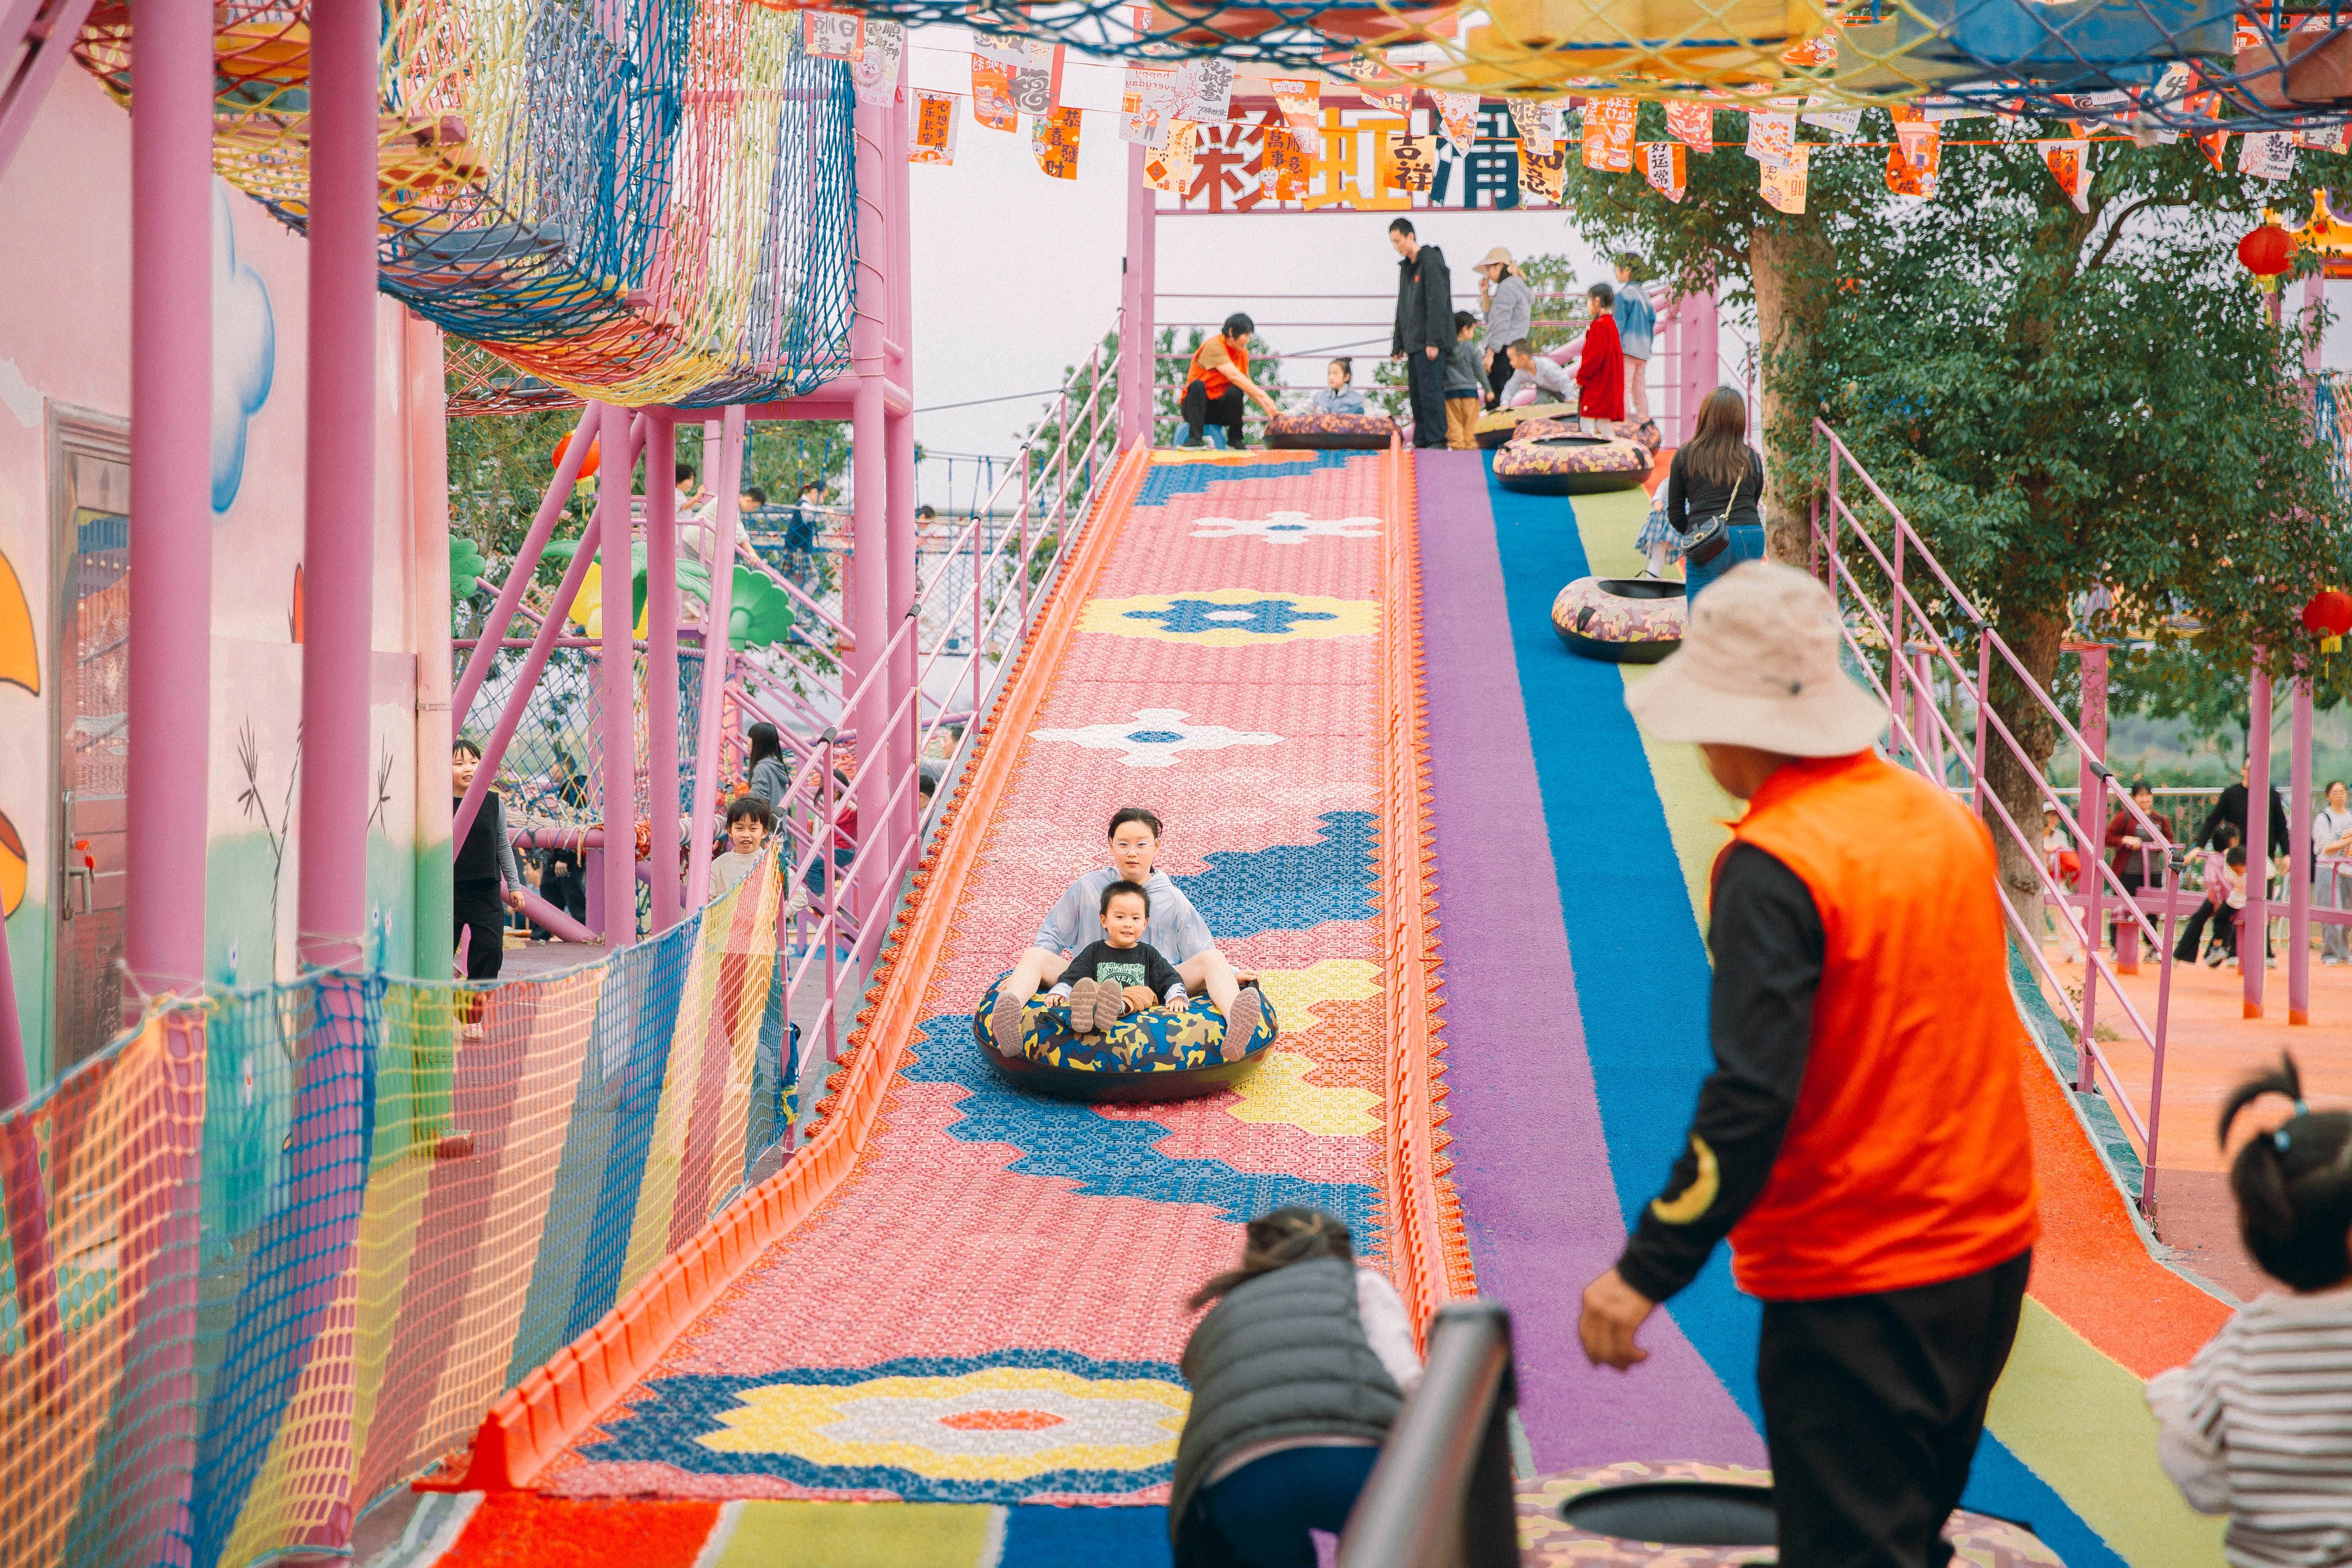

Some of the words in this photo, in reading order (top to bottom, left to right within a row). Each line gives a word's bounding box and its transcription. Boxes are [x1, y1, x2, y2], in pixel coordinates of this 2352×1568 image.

[1183, 104, 1575, 213] 彩虹滑
[1391, 136, 1432, 191] 吉祥
[1652, 144, 1669, 189] 好运常
